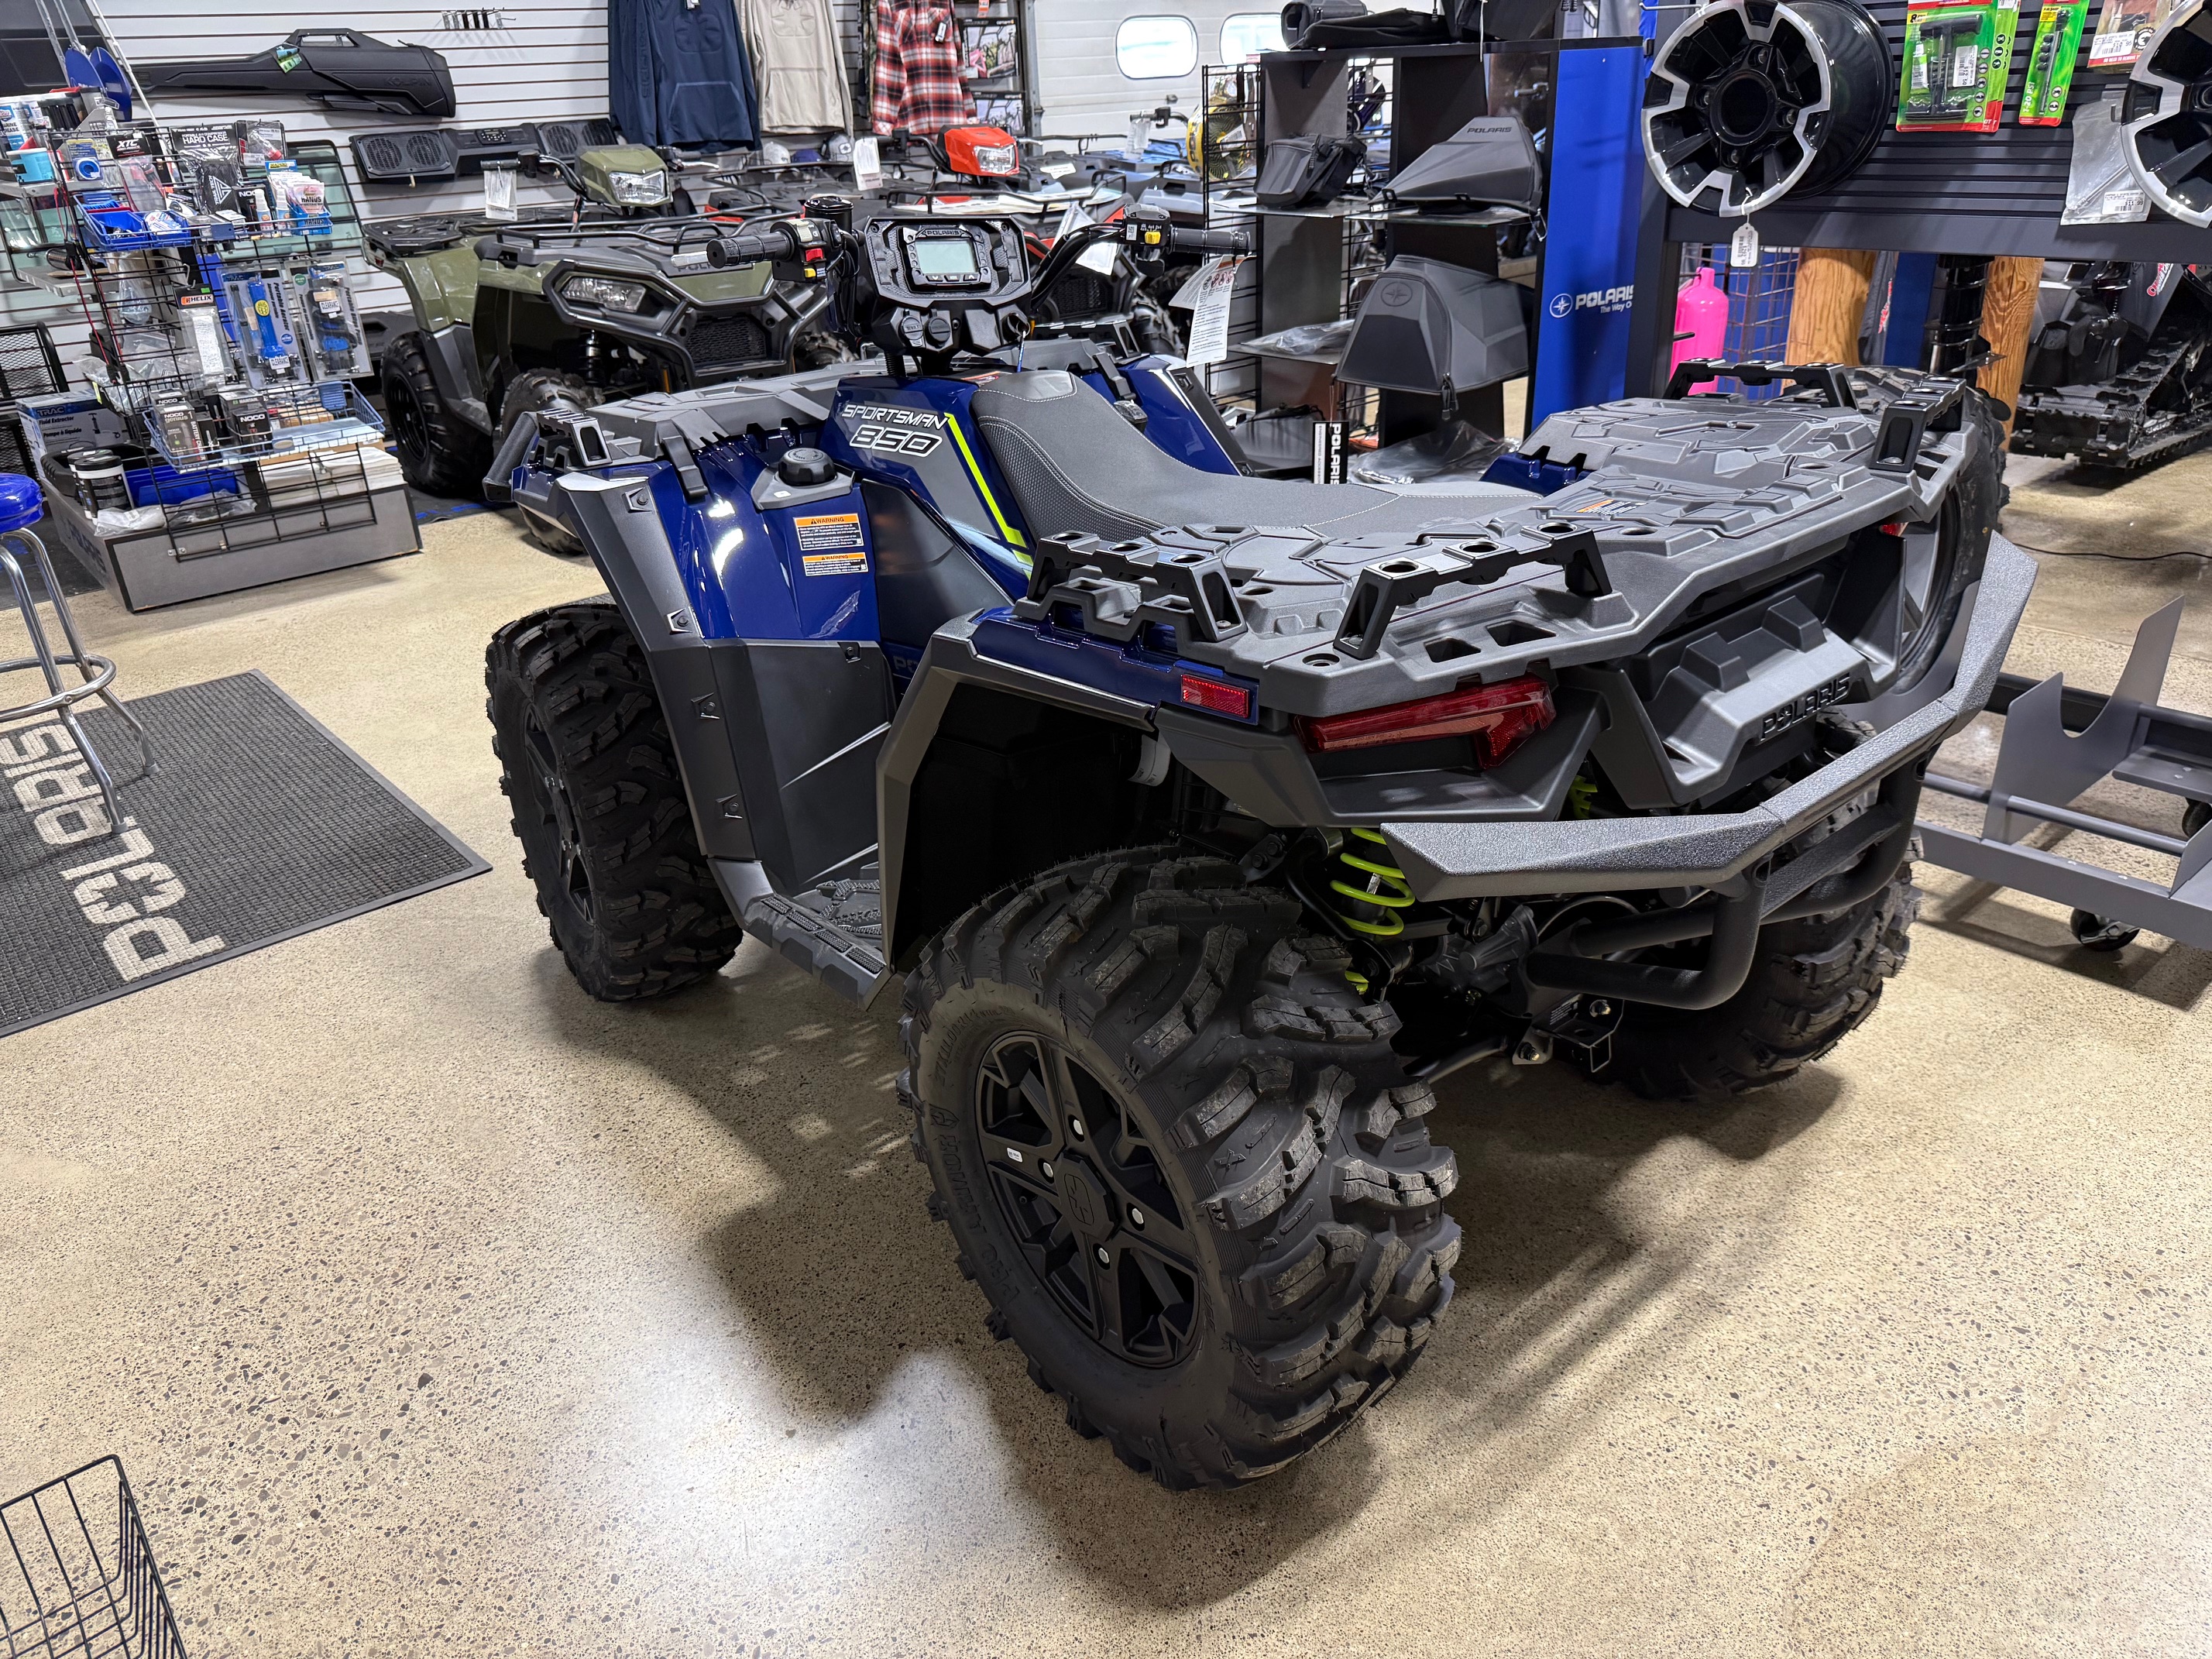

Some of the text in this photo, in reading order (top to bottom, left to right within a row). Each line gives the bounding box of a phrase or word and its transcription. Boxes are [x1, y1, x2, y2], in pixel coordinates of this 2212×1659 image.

[116, 139, 139, 149] XTC
[182, 134, 228, 145] HARD CASE
[273, 283, 284, 307] Portable
[280, 308, 290, 331] Aerator
[344, 287, 355, 311] Portable
[1612, 303, 1625, 312] Way
[36, 407, 65, 417] TRAC
[164, 415, 188, 424] genius
[240, 414, 266, 423] NOCO
[841, 404, 950, 430] SPORTSMAN
[191, 421, 201, 440] BATTERY
[850, 424, 943, 458] 850
[1760, 672, 1850, 741] POLARIS
[0, 724, 226, 982] POLARIS
